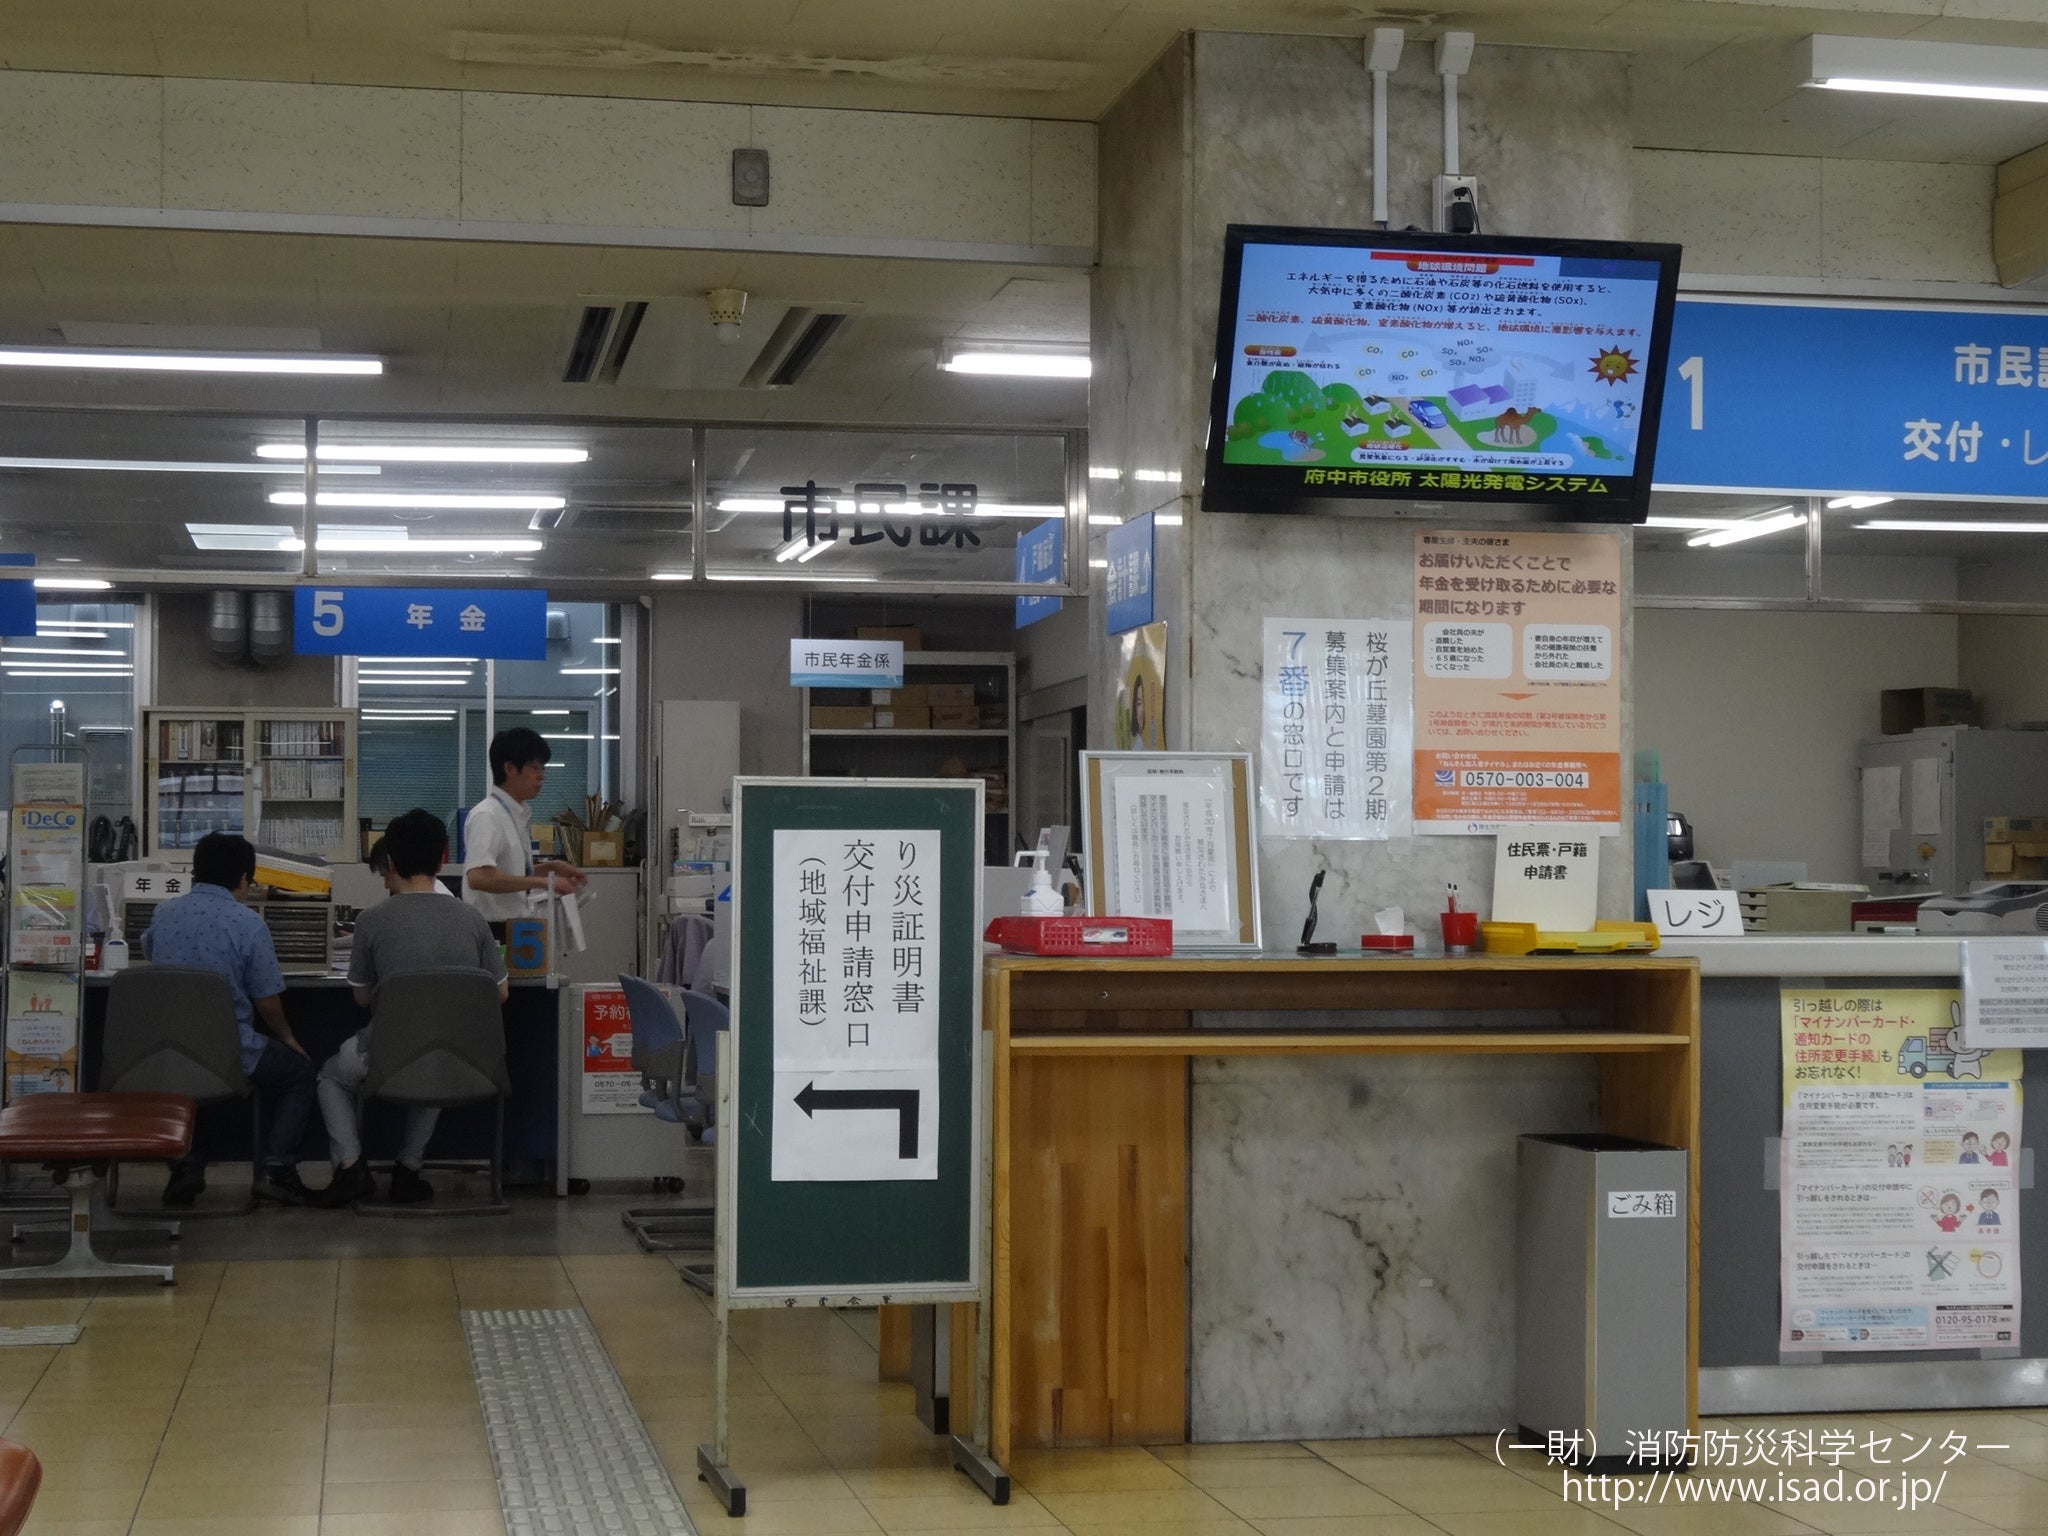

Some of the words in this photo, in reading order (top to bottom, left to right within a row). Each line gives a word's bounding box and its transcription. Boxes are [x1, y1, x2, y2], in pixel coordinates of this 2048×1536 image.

[1678, 356, 1704, 431] 1
[1304, 468, 1411, 487] 府中市役所
[1419, 473, 1608, 494] 太陽光発電システム
[780, 480, 981, 548] 市民課
[1419, 552, 1571, 571] お届けいただくことで
[1419, 576, 1617, 595] 年金を受け取るために必要な
[312, 591, 344, 637] 5
[1419, 599, 1526, 616] 期間になります
[1442, 628, 1485, 637] 会社員の夫が
[804, 651, 890, 670] 市民年金係
[1279, 631, 1309, 817] 7番の窓口です
[1324, 630, 1346, 819] 募集案内と申請は
[1365, 631, 1388, 821] 桜が丘墓園第2期
[1466, 772, 1584, 788] 0570-003-004
[21, 810, 76, 827] iDeCo
[1507, 842, 1588, 857] 住民票・戸籍
[1524, 865, 1568, 880] 申請書
[135, 877, 181, 893] 年金
[1665, 899, 1724, 928] レジ
[892, 840, 925, 1013] り災証明書
[513, 922, 543, 970] 5
[842, 839, 875, 1048] 交付申請窓口
[593, 1004, 632, 1021] 予約
[1793, 998, 1883, 1012] 引っ越しの際は
[1794, 1033, 1871, 1047] 通知カードの
[1795, 1050, 1892, 1063] 住所変更手続」も
[1612, 1193, 1674, 1216] ごみ箱
[1935, 1315, 1998, 1325] 0120-95-0178
